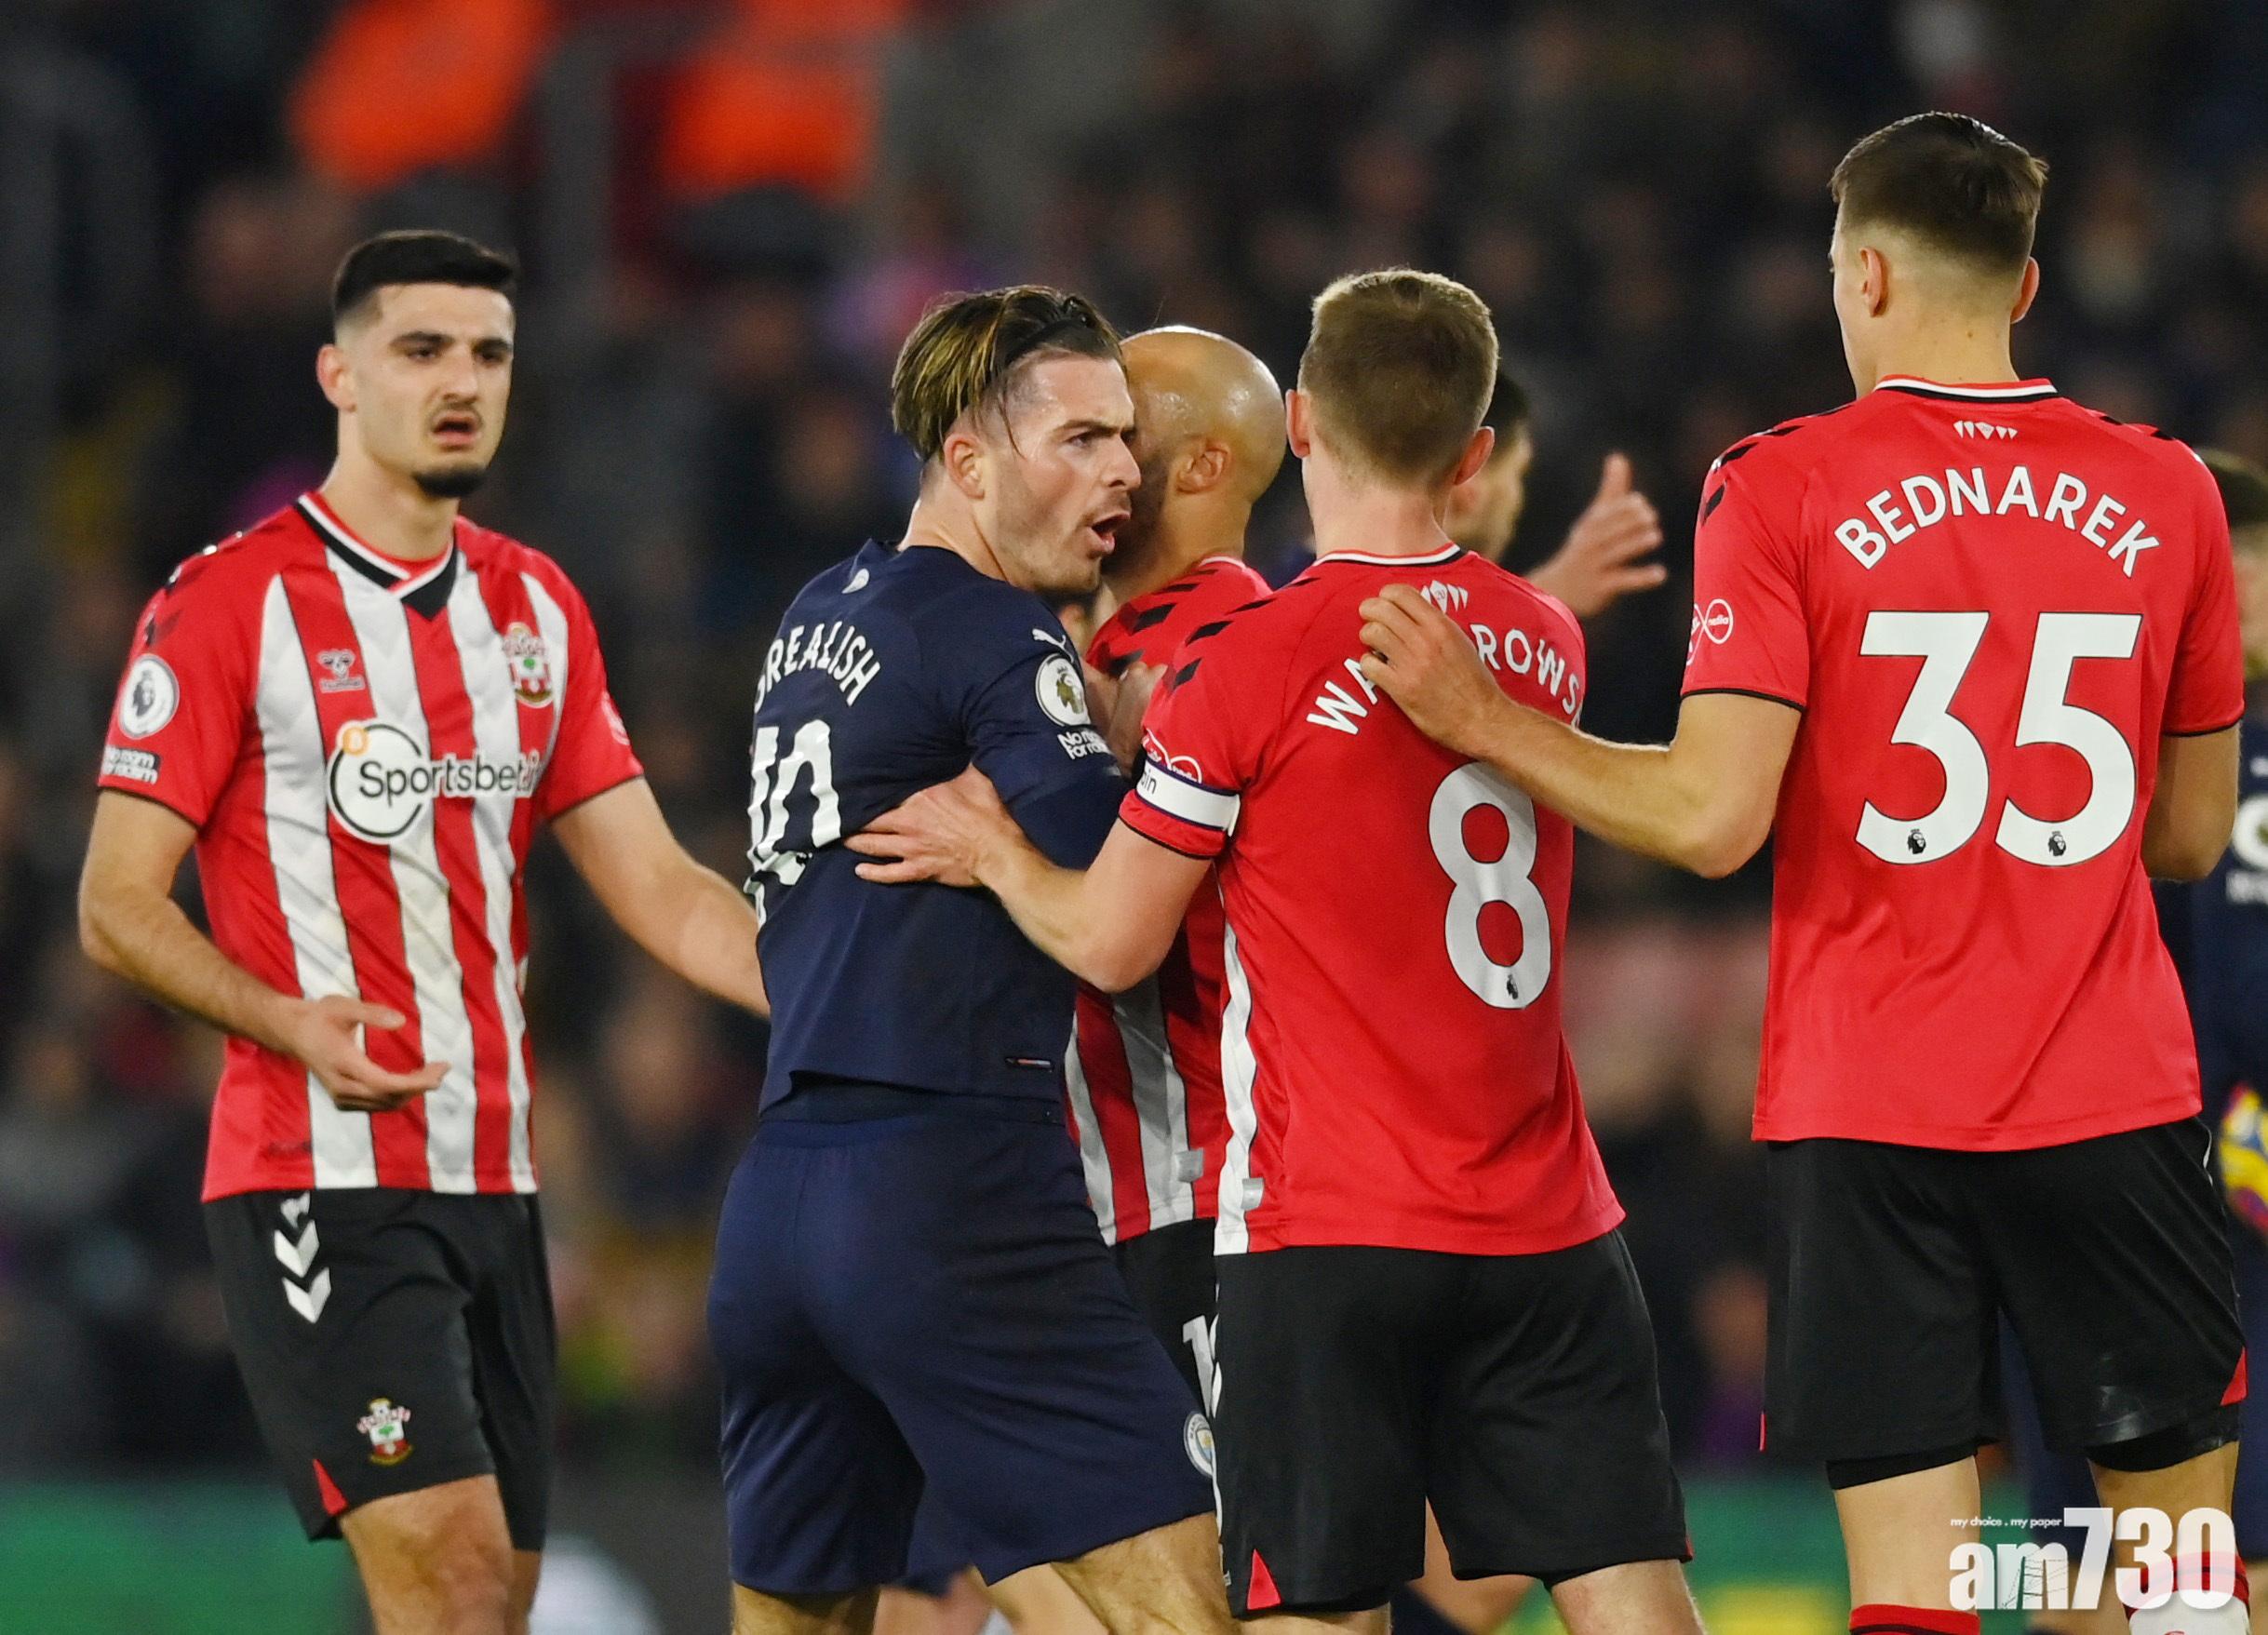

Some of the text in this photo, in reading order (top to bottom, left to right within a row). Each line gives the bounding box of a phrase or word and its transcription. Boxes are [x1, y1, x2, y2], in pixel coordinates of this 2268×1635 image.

[1833, 465, 2160, 577] BEDNAREK
[1855, 610, 2143, 867] 35
[1429, 761, 1551, 1010] 8
